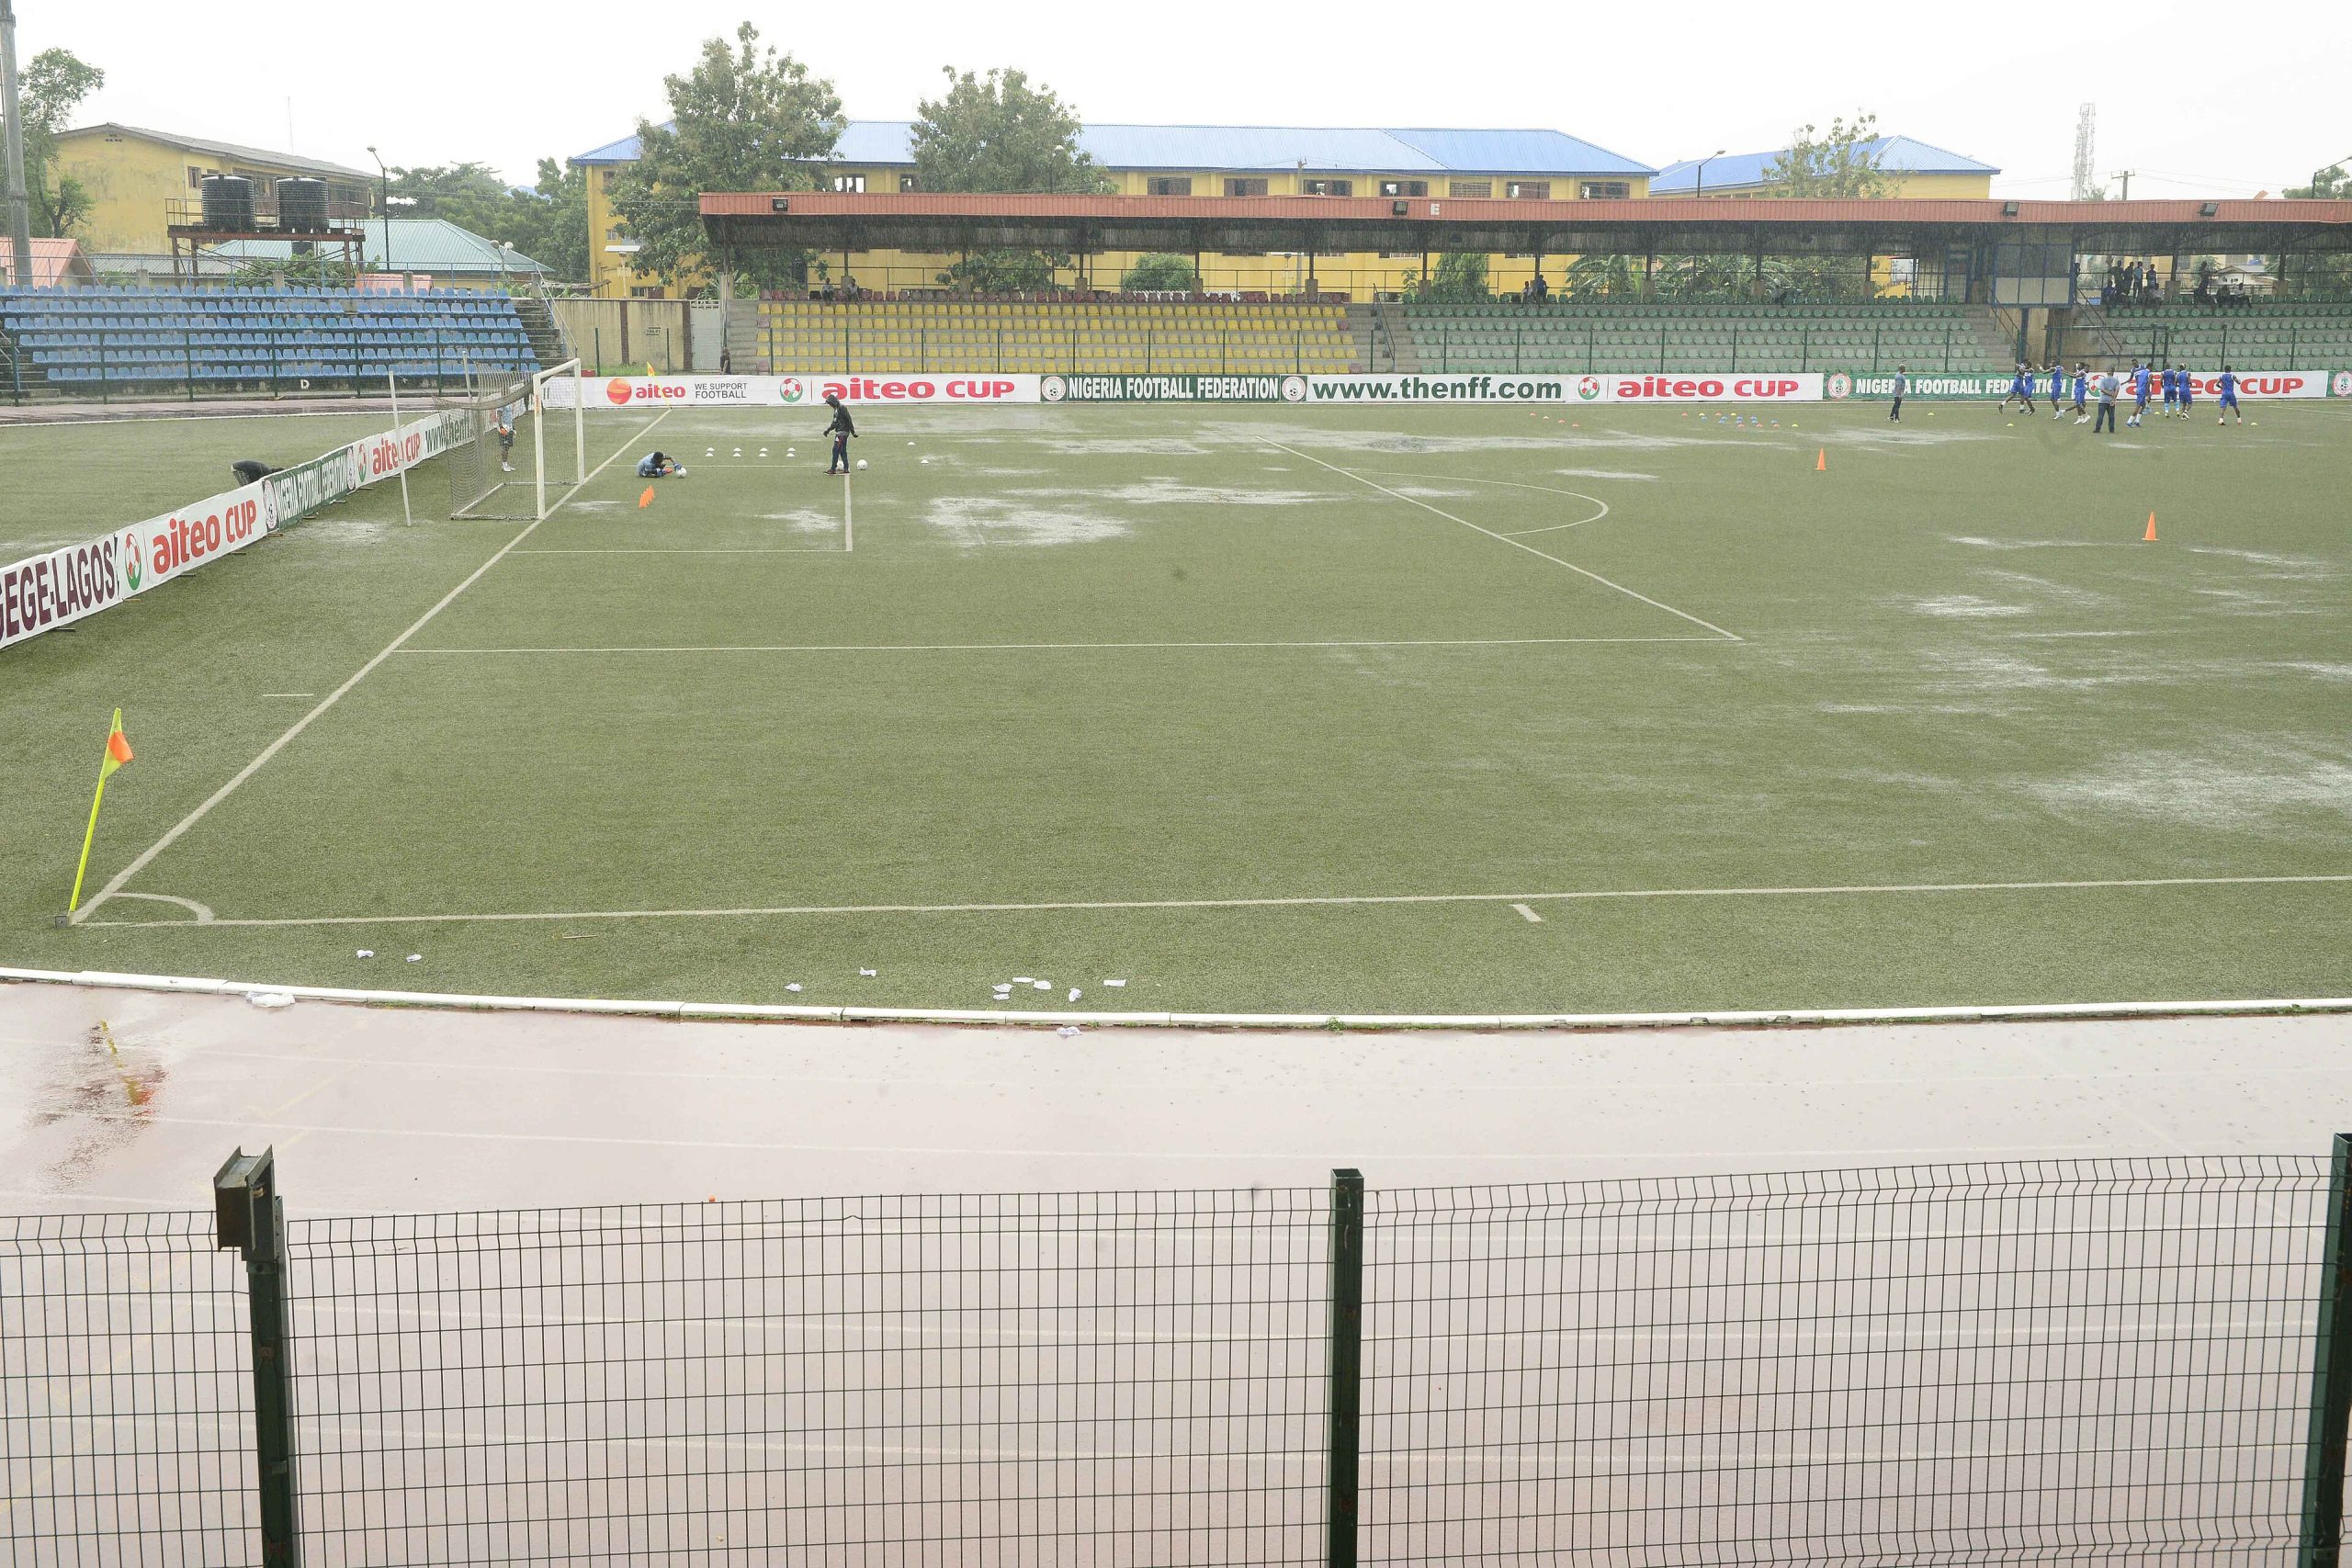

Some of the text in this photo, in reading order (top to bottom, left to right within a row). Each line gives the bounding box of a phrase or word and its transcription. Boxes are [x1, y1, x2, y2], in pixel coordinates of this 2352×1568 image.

[636, 383, 686, 399] aiteo
[695, 390, 747, 399] FOOTBALL
[709, 382, 748, 390] SUPPORT
[821, 378, 1014, 400] aiteo CUP
[1069, 378, 1123, 399] NIGERIA
[1126, 378, 1193, 399] FOOTBALL
[1197, 378, 1278, 399] FEDERATION
[1313, 377, 1561, 399] www.thenff.com
[1617, 376, 1798, 397] aiteo CUP
[1856, 378, 1911, 394] NIGERA
[1916, 378, 1981, 394] FOOTBALL
[1985, 378, 2067, 394] FEDTION
[2125, 374, 2303, 395] ieo CUP
[405, 432, 421, 462] CUP
[153, 514, 221, 574] aiteo
[225, 499, 257, 544] CUP
